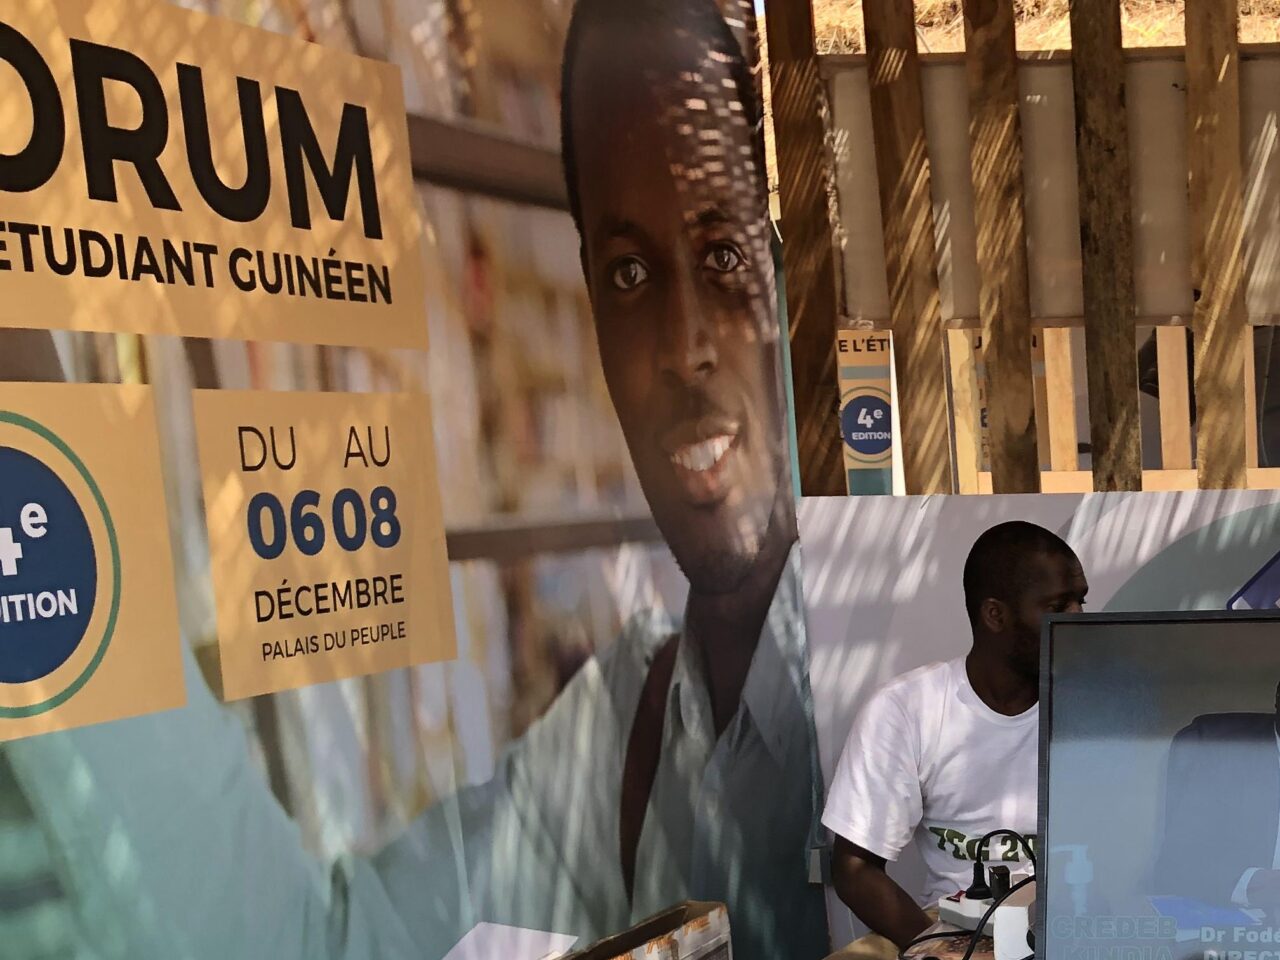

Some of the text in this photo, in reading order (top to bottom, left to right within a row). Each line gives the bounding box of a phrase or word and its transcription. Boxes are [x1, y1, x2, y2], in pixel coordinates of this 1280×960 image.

[228, 247, 393, 304] GUINÉEN
[237, 425, 392, 472] DU AU
[851, 431, 891, 441] EDITION
[254, 573, 405, 623] DÉCEMBRE
[262, 621, 407, 662] PALAIS DU PEUPLE
[1051, 915, 1178, 940] CREDEB
[1201, 926, 1228, 943] Dr
